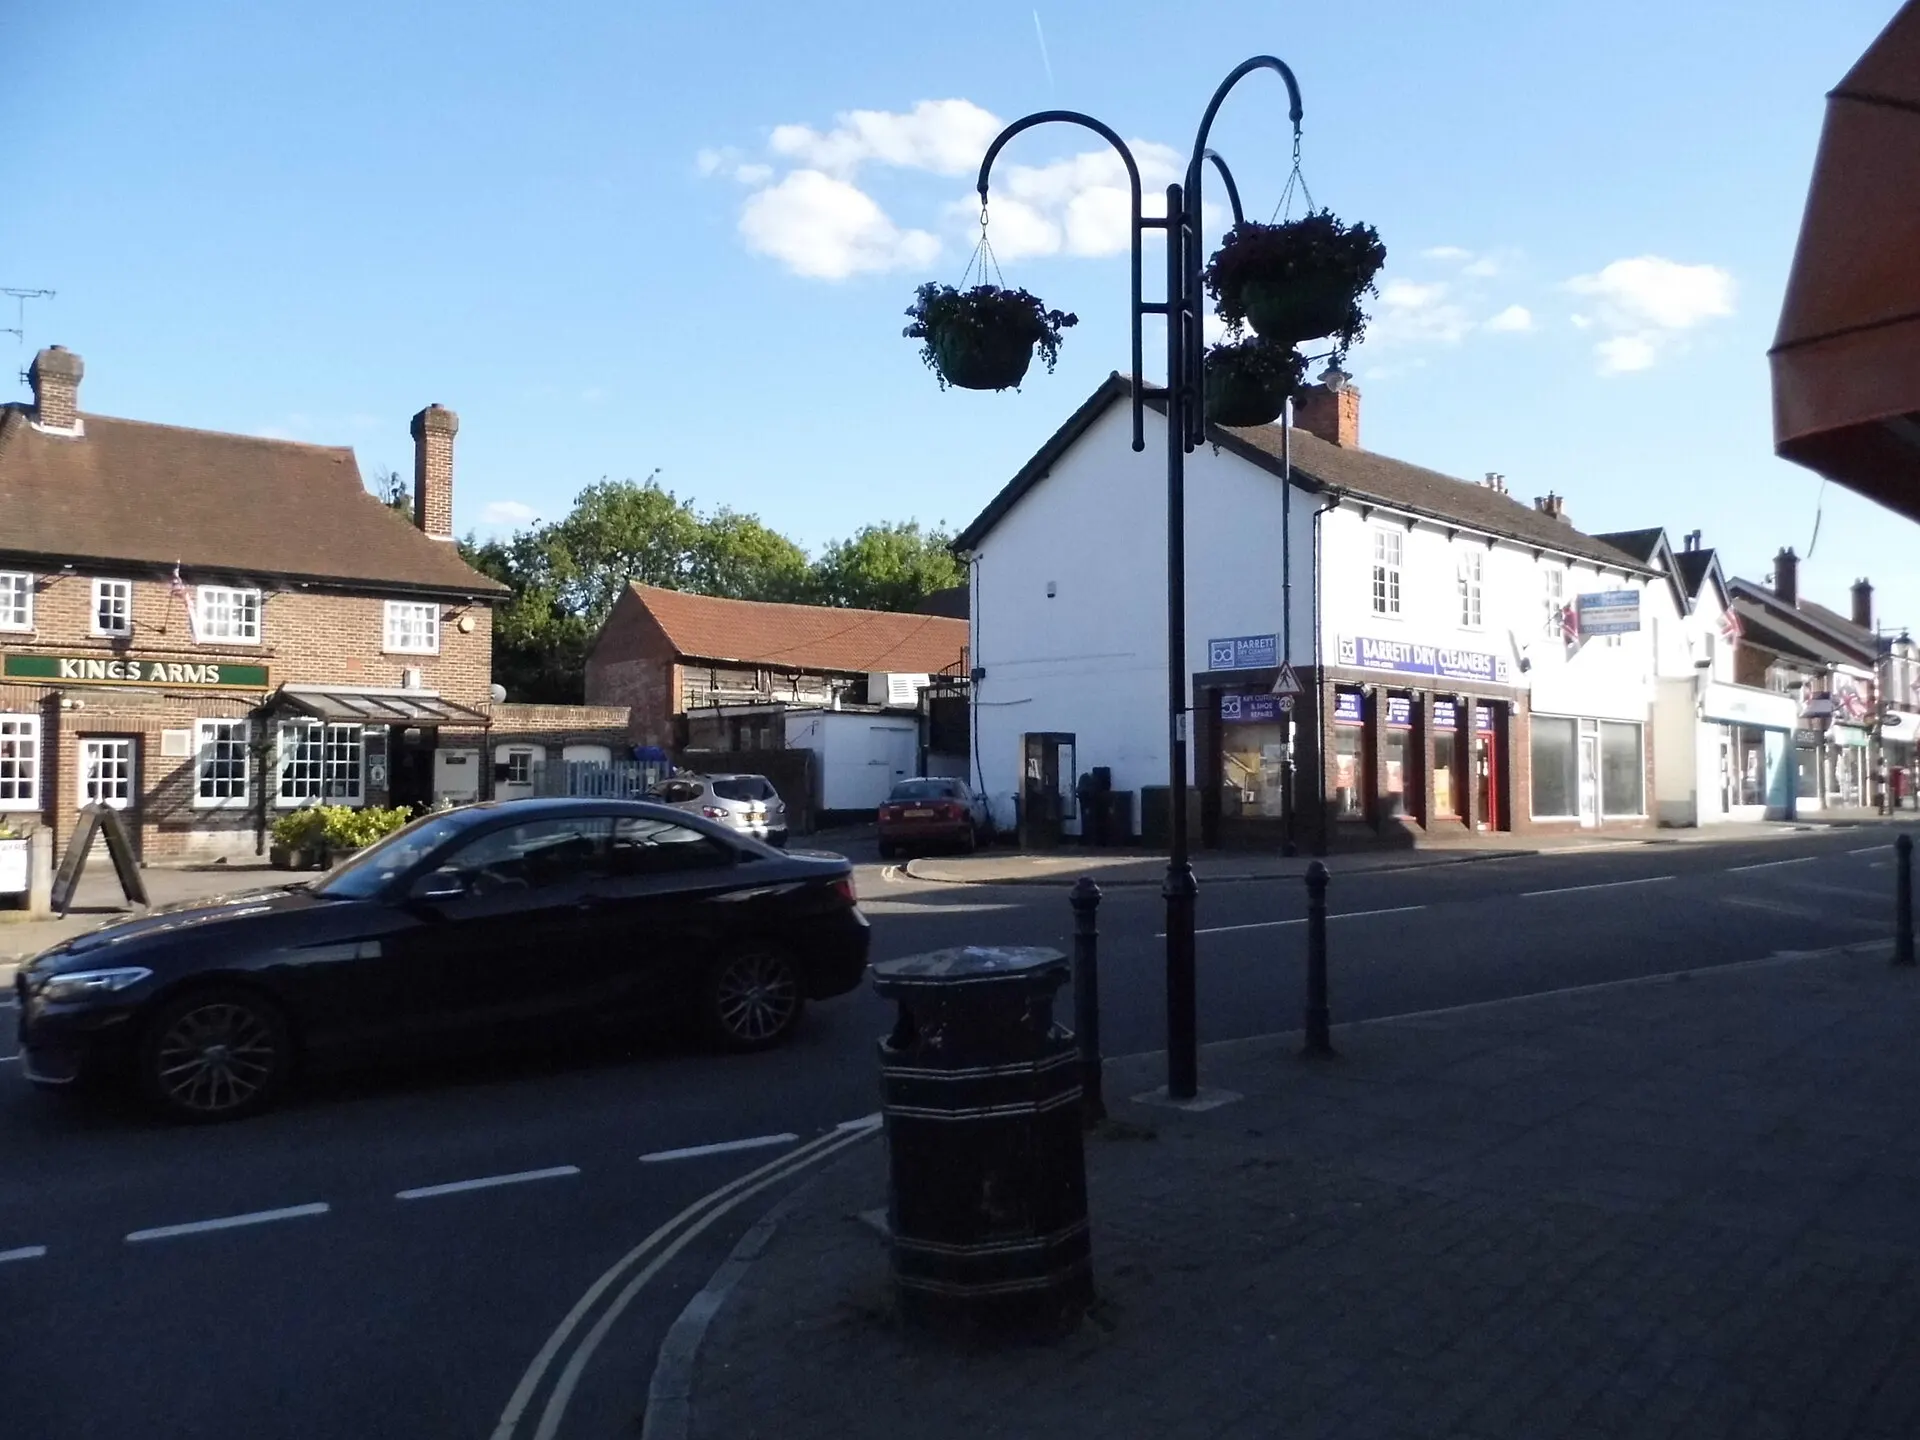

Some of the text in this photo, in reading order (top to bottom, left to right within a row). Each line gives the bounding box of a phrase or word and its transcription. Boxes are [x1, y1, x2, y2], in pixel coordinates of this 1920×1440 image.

[1237, 638, 1274, 649] BARRETT
[1362, 638, 1411, 663] BARRETT
[1413, 645, 1435, 666] DRY
[1438, 650, 1491, 673] CLEANERS
[60, 658, 220, 684] KINGS ARMS
